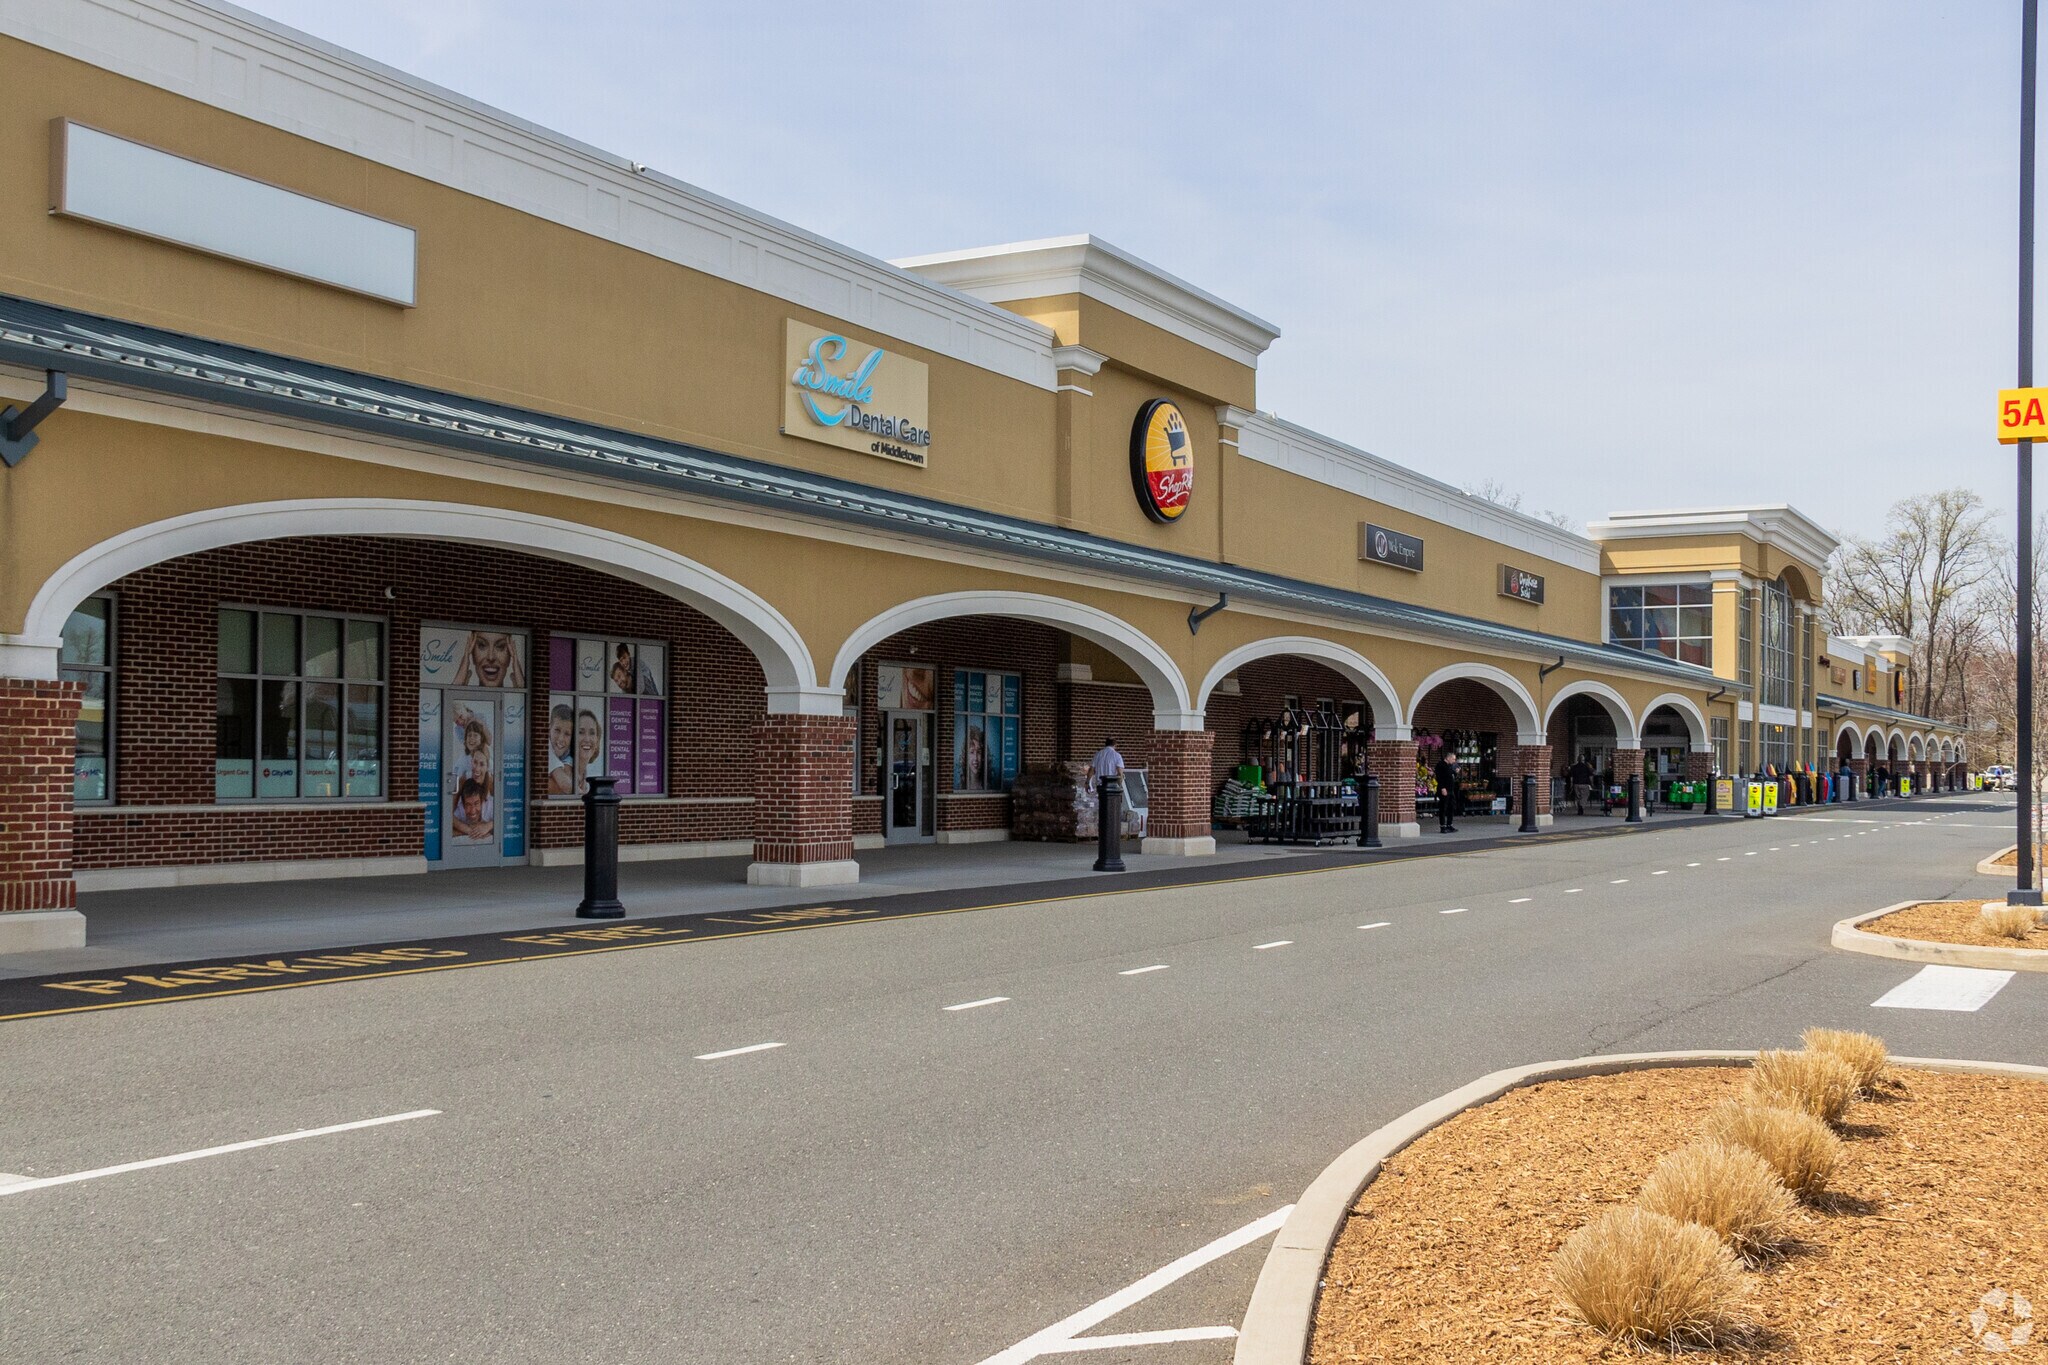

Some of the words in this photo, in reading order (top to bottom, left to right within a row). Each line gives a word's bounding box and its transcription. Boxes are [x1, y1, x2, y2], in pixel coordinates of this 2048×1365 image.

[793, 335, 885, 404] iSmile
[2003, 398, 2045, 427] 5A
[849, 404, 896, 438] Dental
[899, 418, 931, 447] Care
[871, 442, 880, 453] of
[880, 442, 924, 464] Middletown
[1399, 543, 1415, 563] Empire
[217, 769, 235, 777] Urgent
[271, 769, 293, 777] CityMD
[356, 769, 376, 777] CityMD
[40, 947, 469, 994] PARKING
[500, 925, 694, 946] FIRE
[704, 907, 881, 925] LANE
